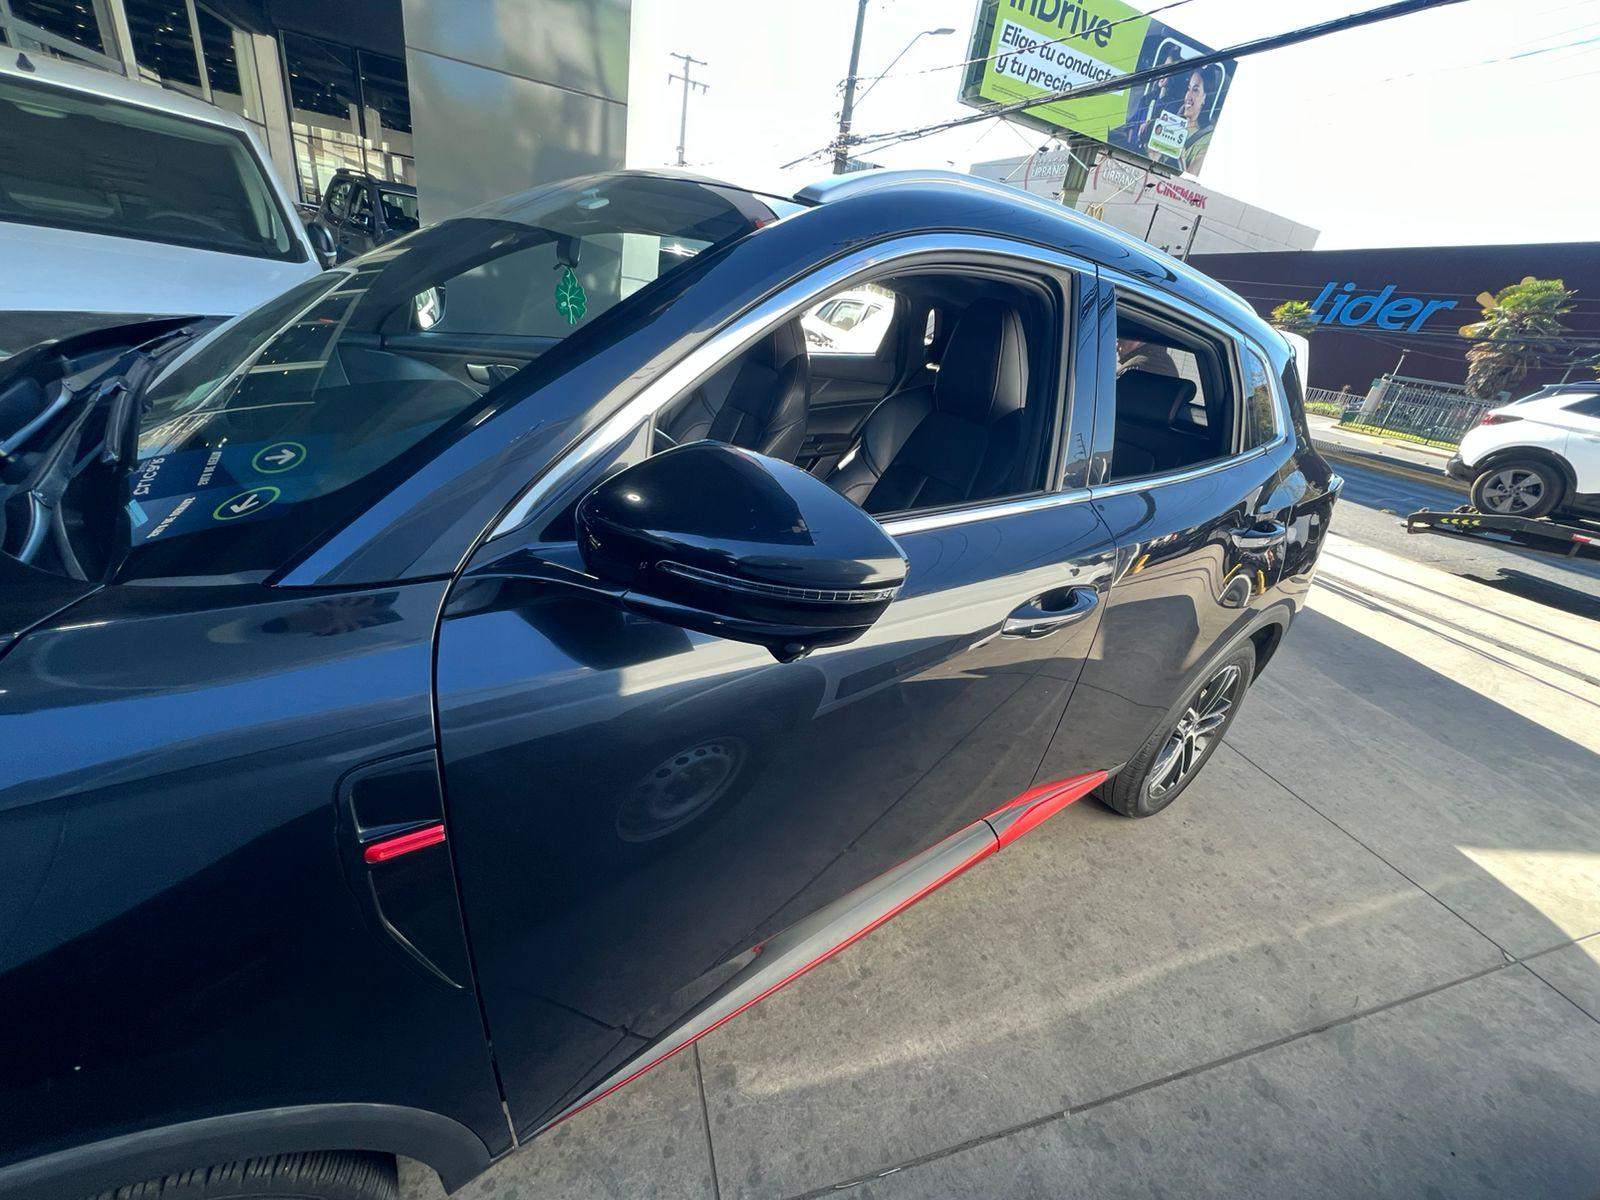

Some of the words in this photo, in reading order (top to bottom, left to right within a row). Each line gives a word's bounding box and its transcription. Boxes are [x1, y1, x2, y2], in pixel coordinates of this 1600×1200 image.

[1039, 43, 1056, 62] tu
[995, 55, 1009, 74] y
[1010, 56, 1028, 77] tu
